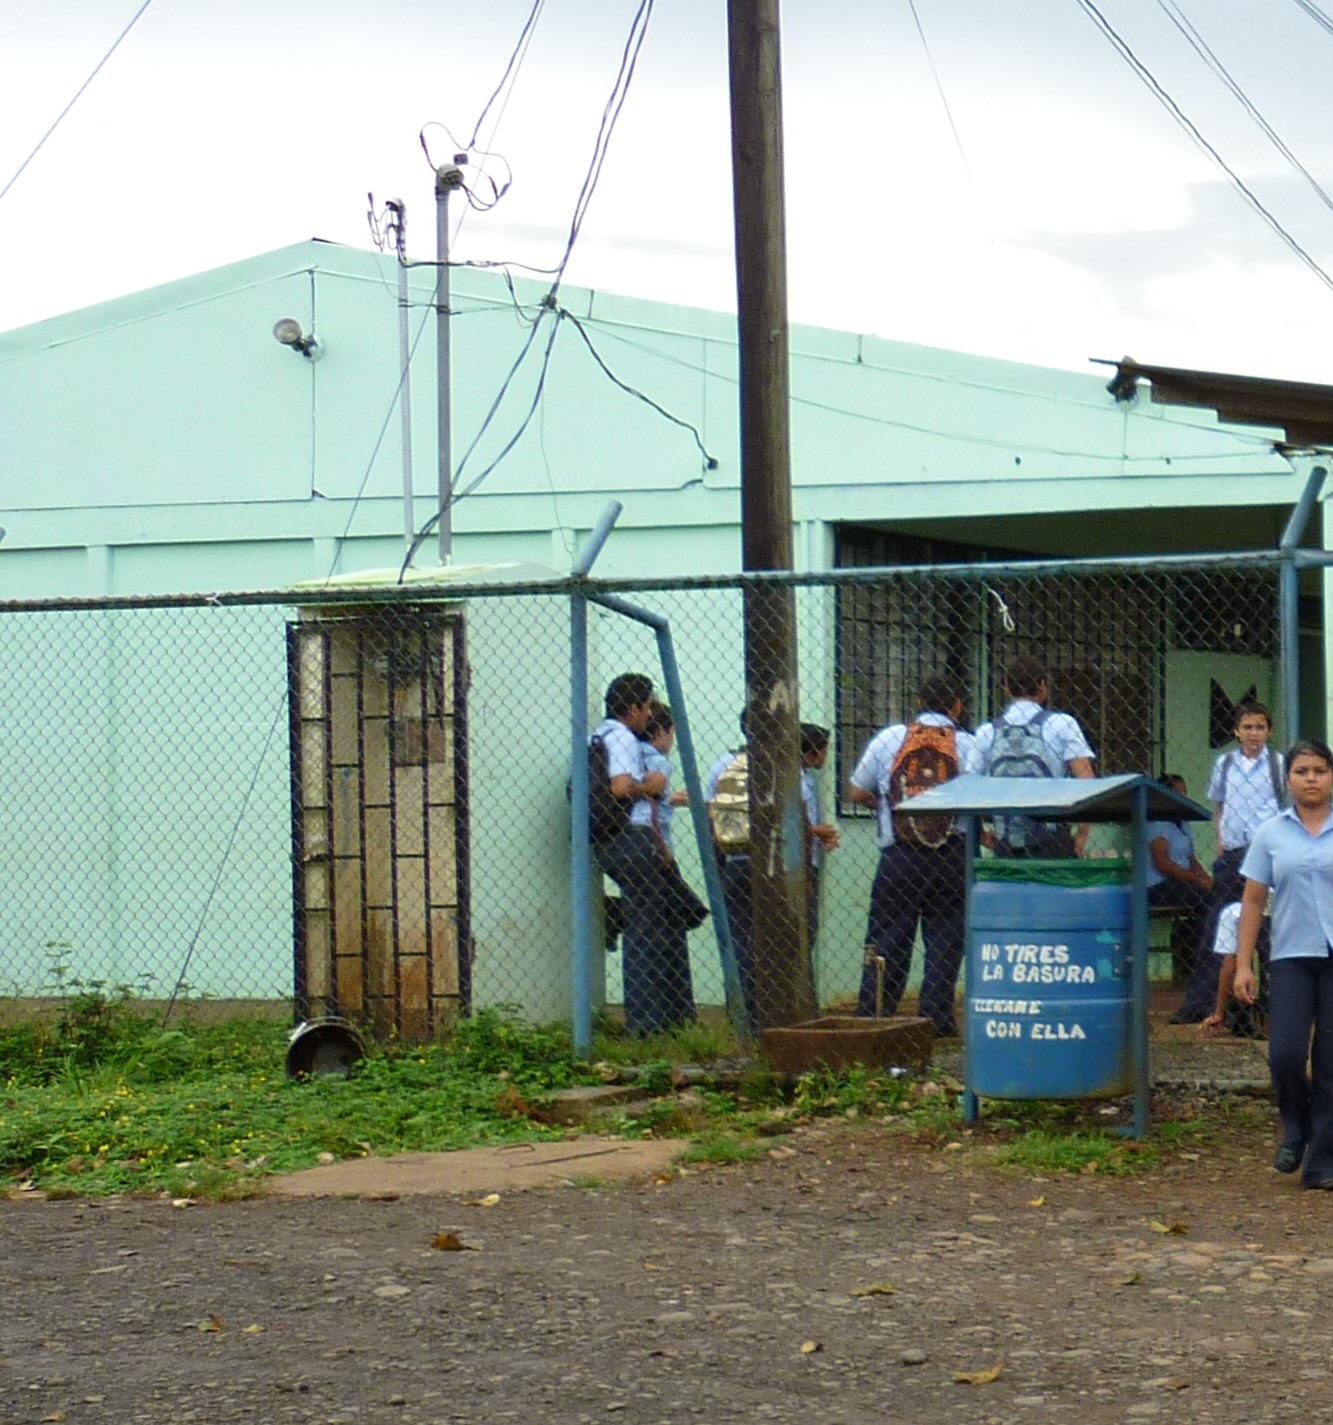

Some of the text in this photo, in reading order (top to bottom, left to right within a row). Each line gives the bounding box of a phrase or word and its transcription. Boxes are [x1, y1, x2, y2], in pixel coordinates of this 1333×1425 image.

[981, 943, 1070, 964] NO TIRES
[982, 963, 1095, 984] LA BASURA
[985, 1019, 1087, 1040] CON ELLA
